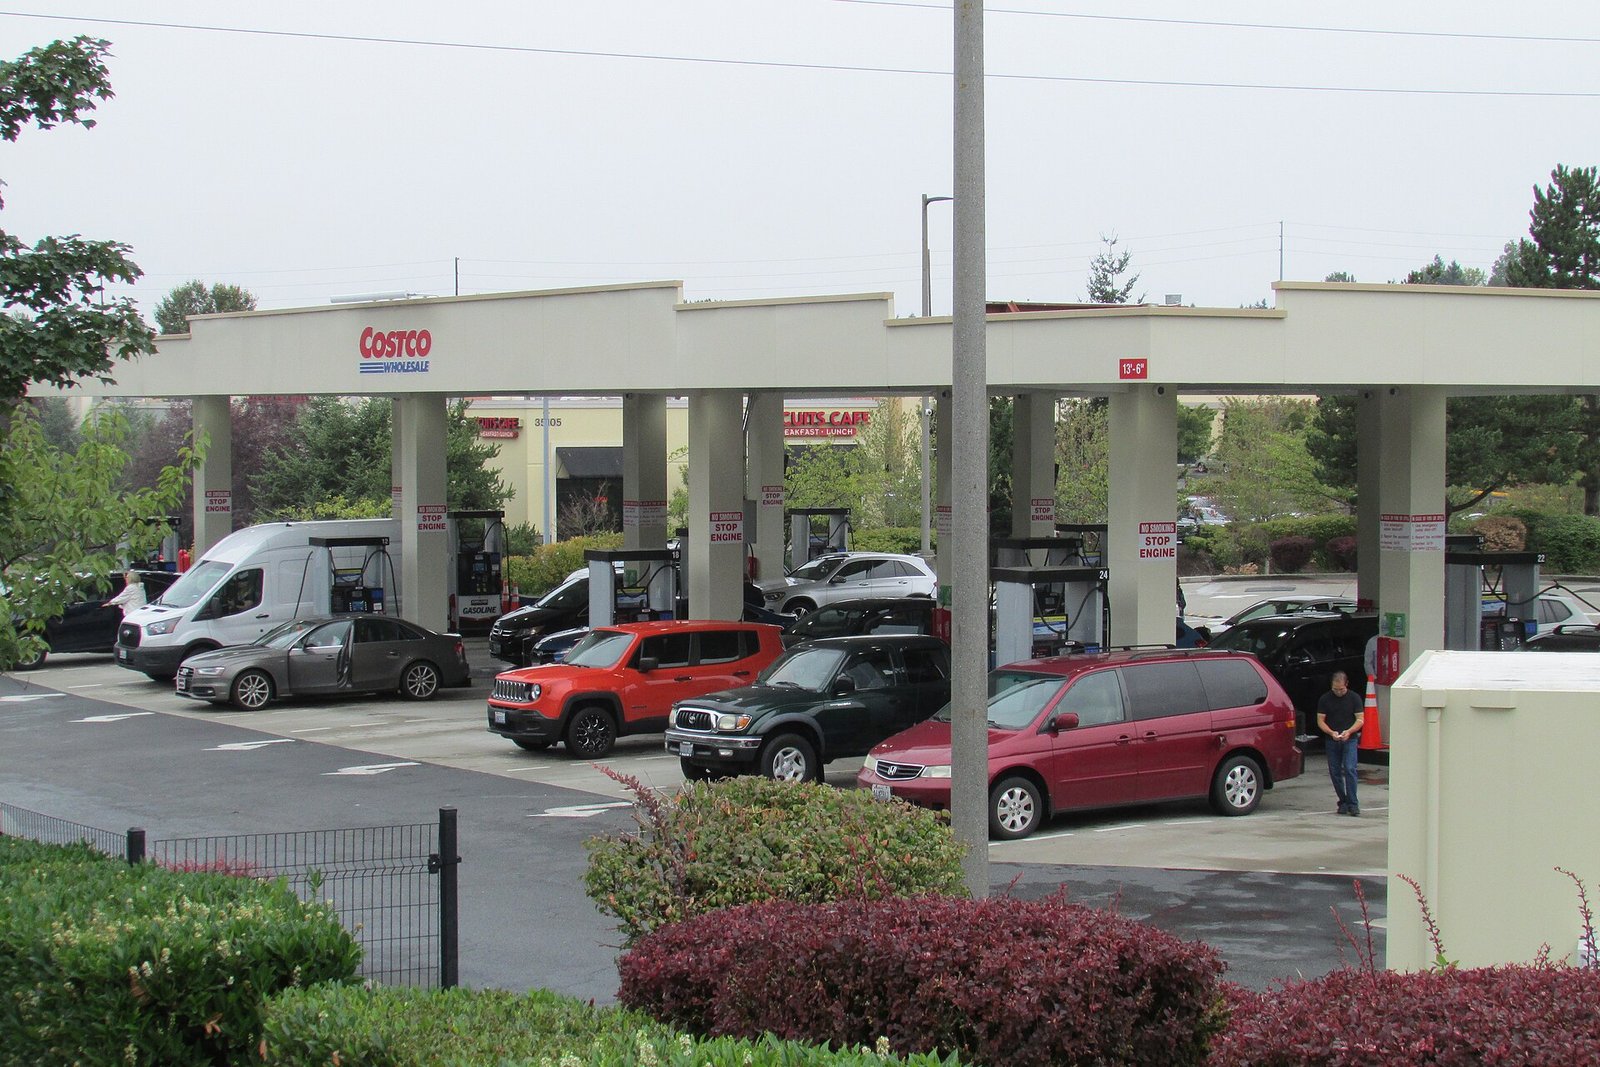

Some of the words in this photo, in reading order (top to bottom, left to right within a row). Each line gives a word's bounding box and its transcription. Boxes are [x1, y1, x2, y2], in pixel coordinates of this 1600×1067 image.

[383, 361, 429, 373] WHOLESALE
[826, 428, 853, 436] LUNCH
[715, 523, 737, 531] STOP
[1141, 523, 1150, 533] NO
[1150, 523, 1175, 533] SMOKING
[711, 533, 742, 541] ENGINE
[1145, 536, 1170, 546] STOP
[1140, 548, 1175, 558] ENGINE
[1537, 554, 1545, 563] 22
[1099, 570, 1108, 579] 24
[463, 606, 497, 614] GASOLINE
